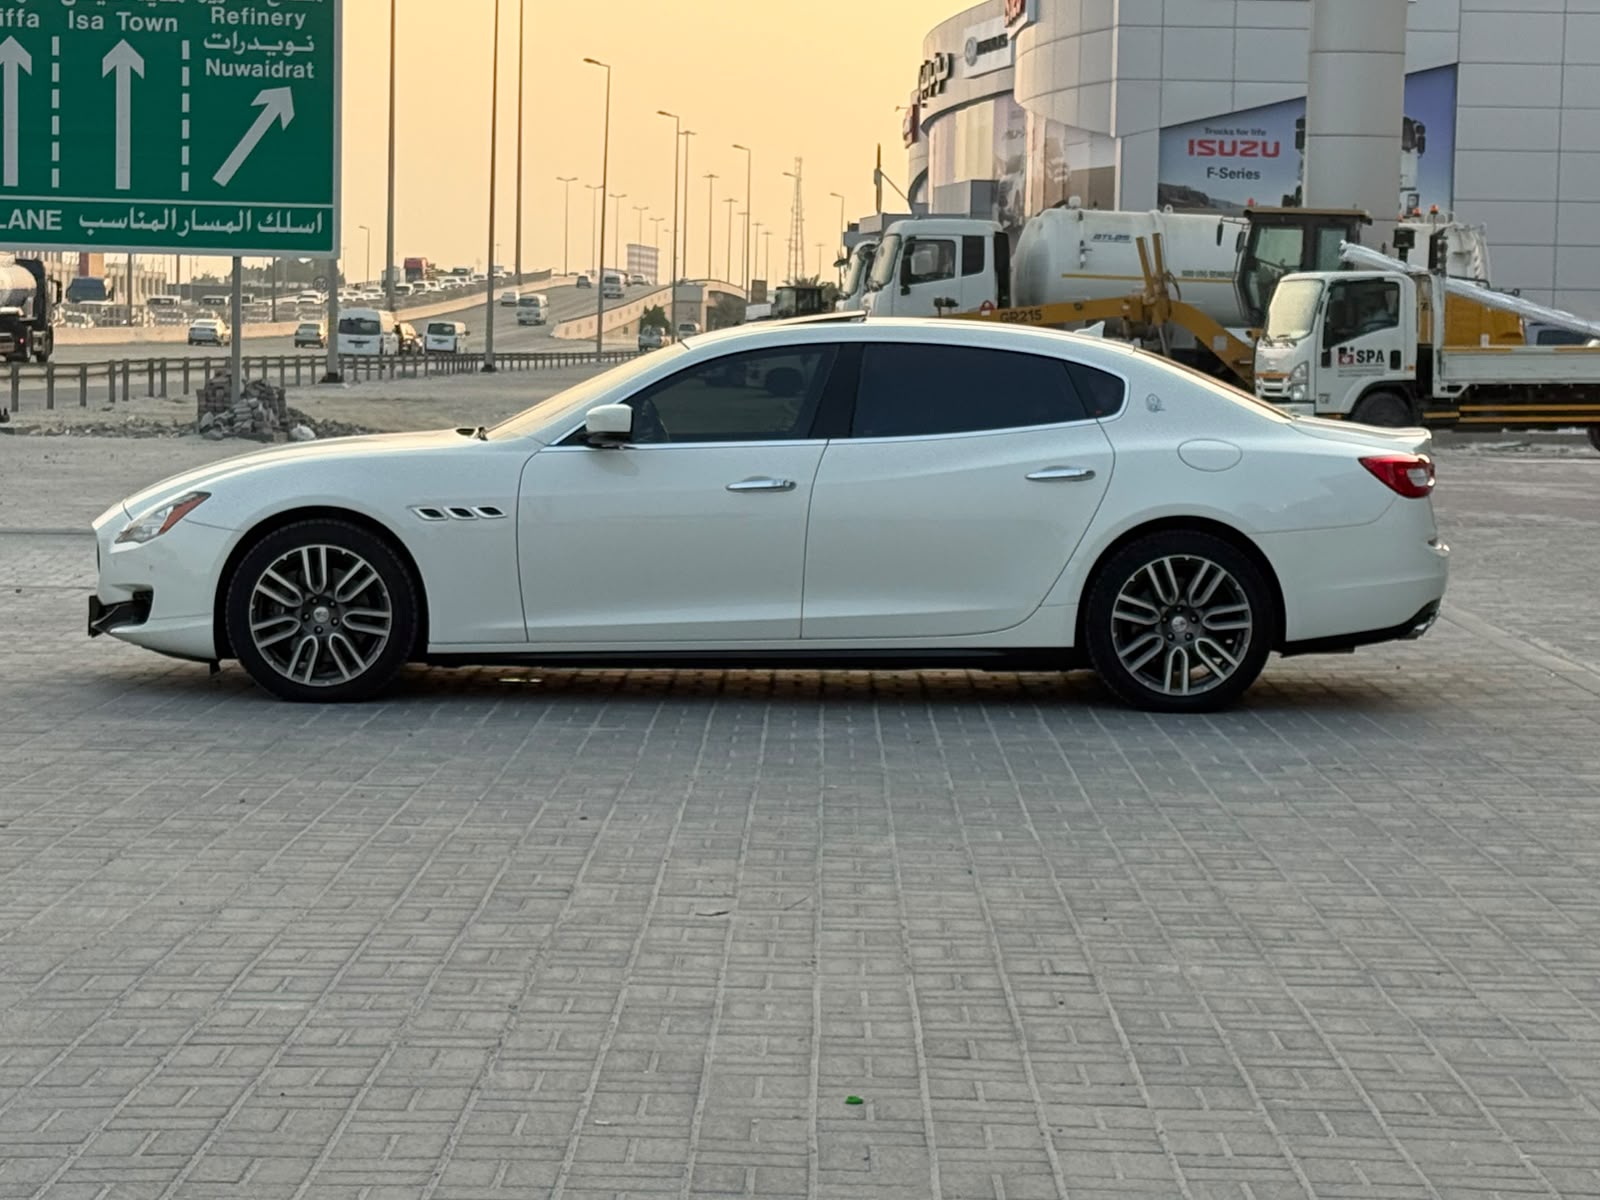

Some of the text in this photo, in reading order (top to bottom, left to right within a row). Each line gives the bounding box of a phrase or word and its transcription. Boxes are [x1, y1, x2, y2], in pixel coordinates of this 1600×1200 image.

[68, 10, 178, 32] Isa Town
[211, 6, 306, 30] Refinery
[203, 31, 315, 57] نويدرات
[205, 58, 315, 79] Nuwaidrat
[1204, 127, 1267, 136] Trucks for life
[1188, 139, 1280, 158] ISUZU
[1206, 166, 1261, 180] F-Series
[78, 206, 323, 237] اسلك المسار المناسب
[1000, 308, 1043, 323] GR215
[1356, 349, 1385, 364] SPA
